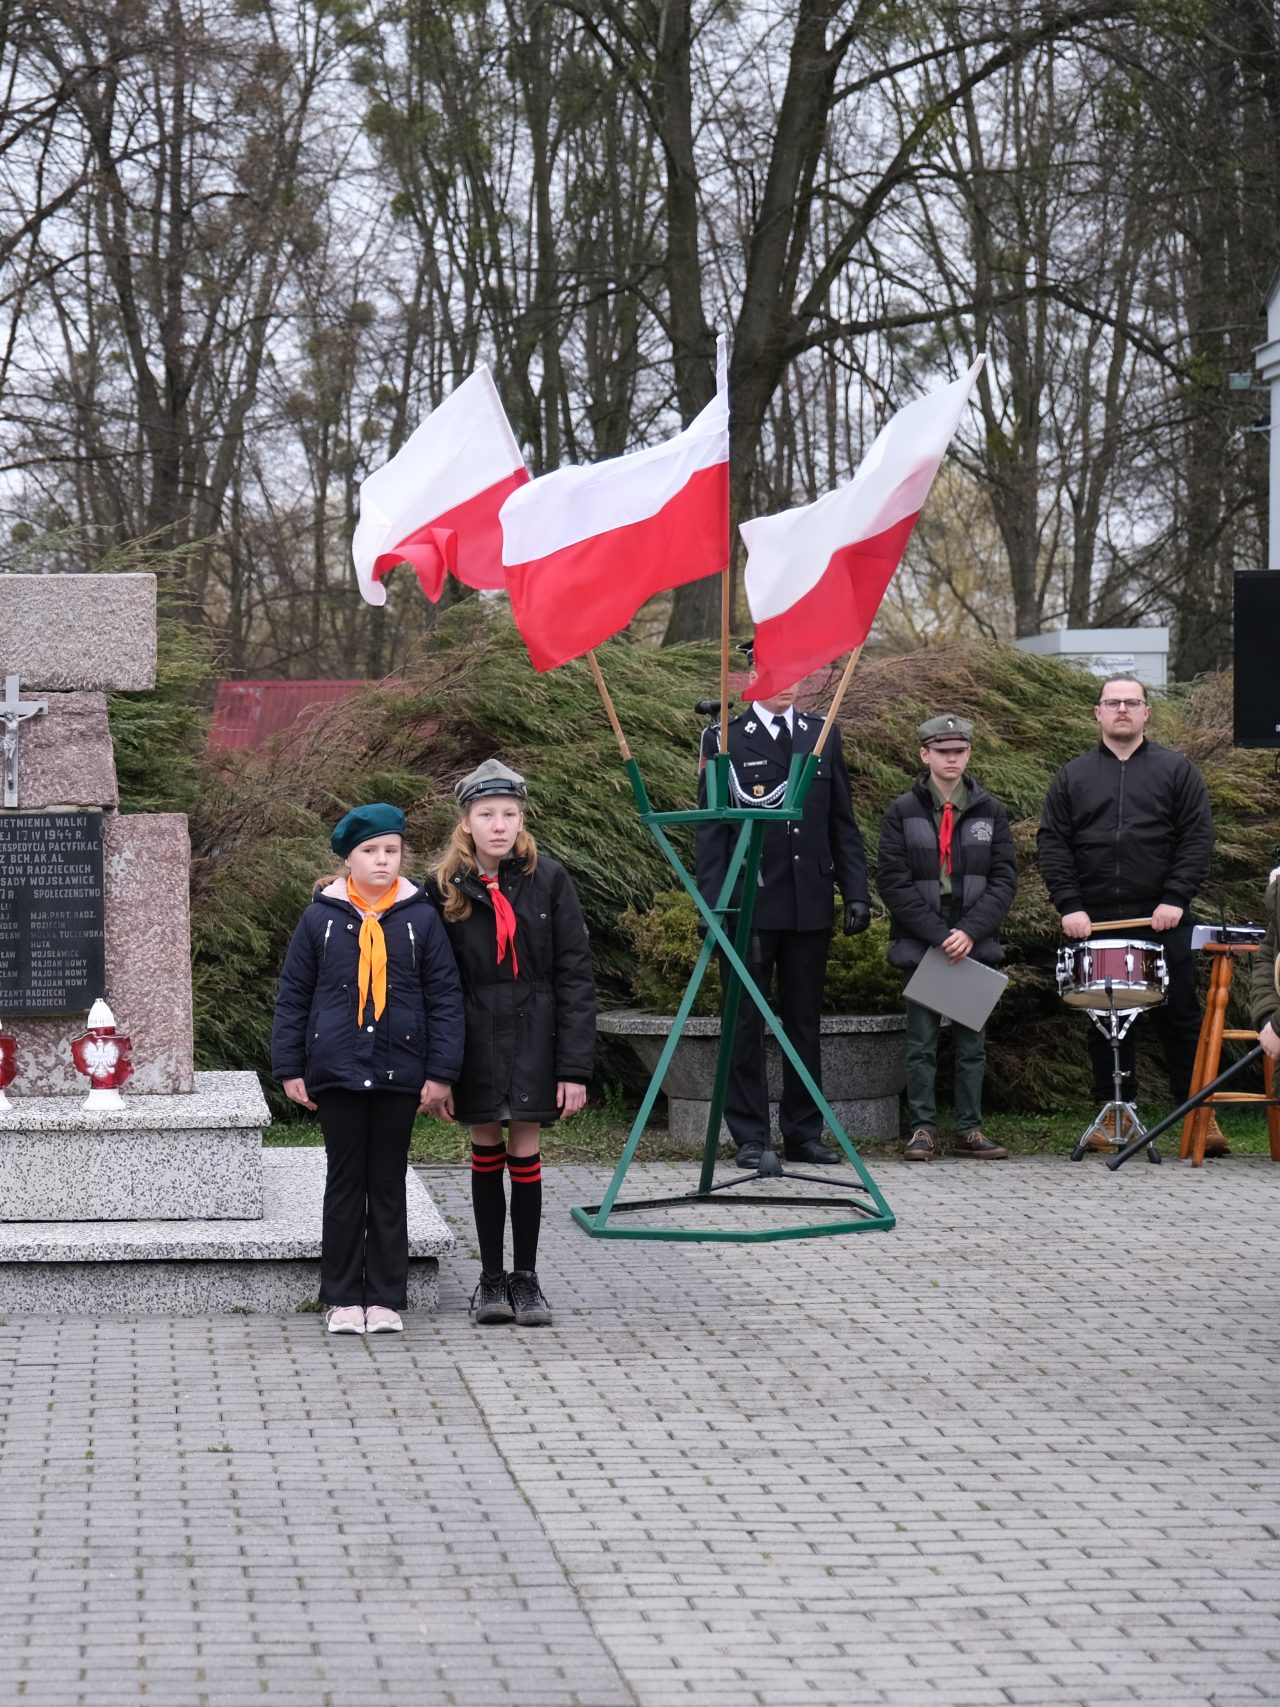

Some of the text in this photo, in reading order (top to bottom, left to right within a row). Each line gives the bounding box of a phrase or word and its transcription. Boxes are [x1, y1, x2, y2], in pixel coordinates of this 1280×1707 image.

[55, 816, 87, 827] WALKI
[31, 830, 41, 840] IV
[44, 829, 72, 840] 1944
[26, 864, 92, 875] RADZIECKICH
[29, 875, 96, 886] WOJSŁAWICE
[30, 940, 52, 950] HUTA
[31, 950, 80, 959] WOJSŁAWICE
[31, 959, 64, 969] MAJDAN
[64, 959, 88, 968] NOWY
[31, 969, 64, 978] MAJDAN
[64, 968, 88, 977] NOWY
[31, 979, 64, 988] MAJDAN
[64, 978, 89, 987] NOWY
[25, 988, 67, 998] RADZIECKI
[25, 998, 68, 1007] RADZIECKI
